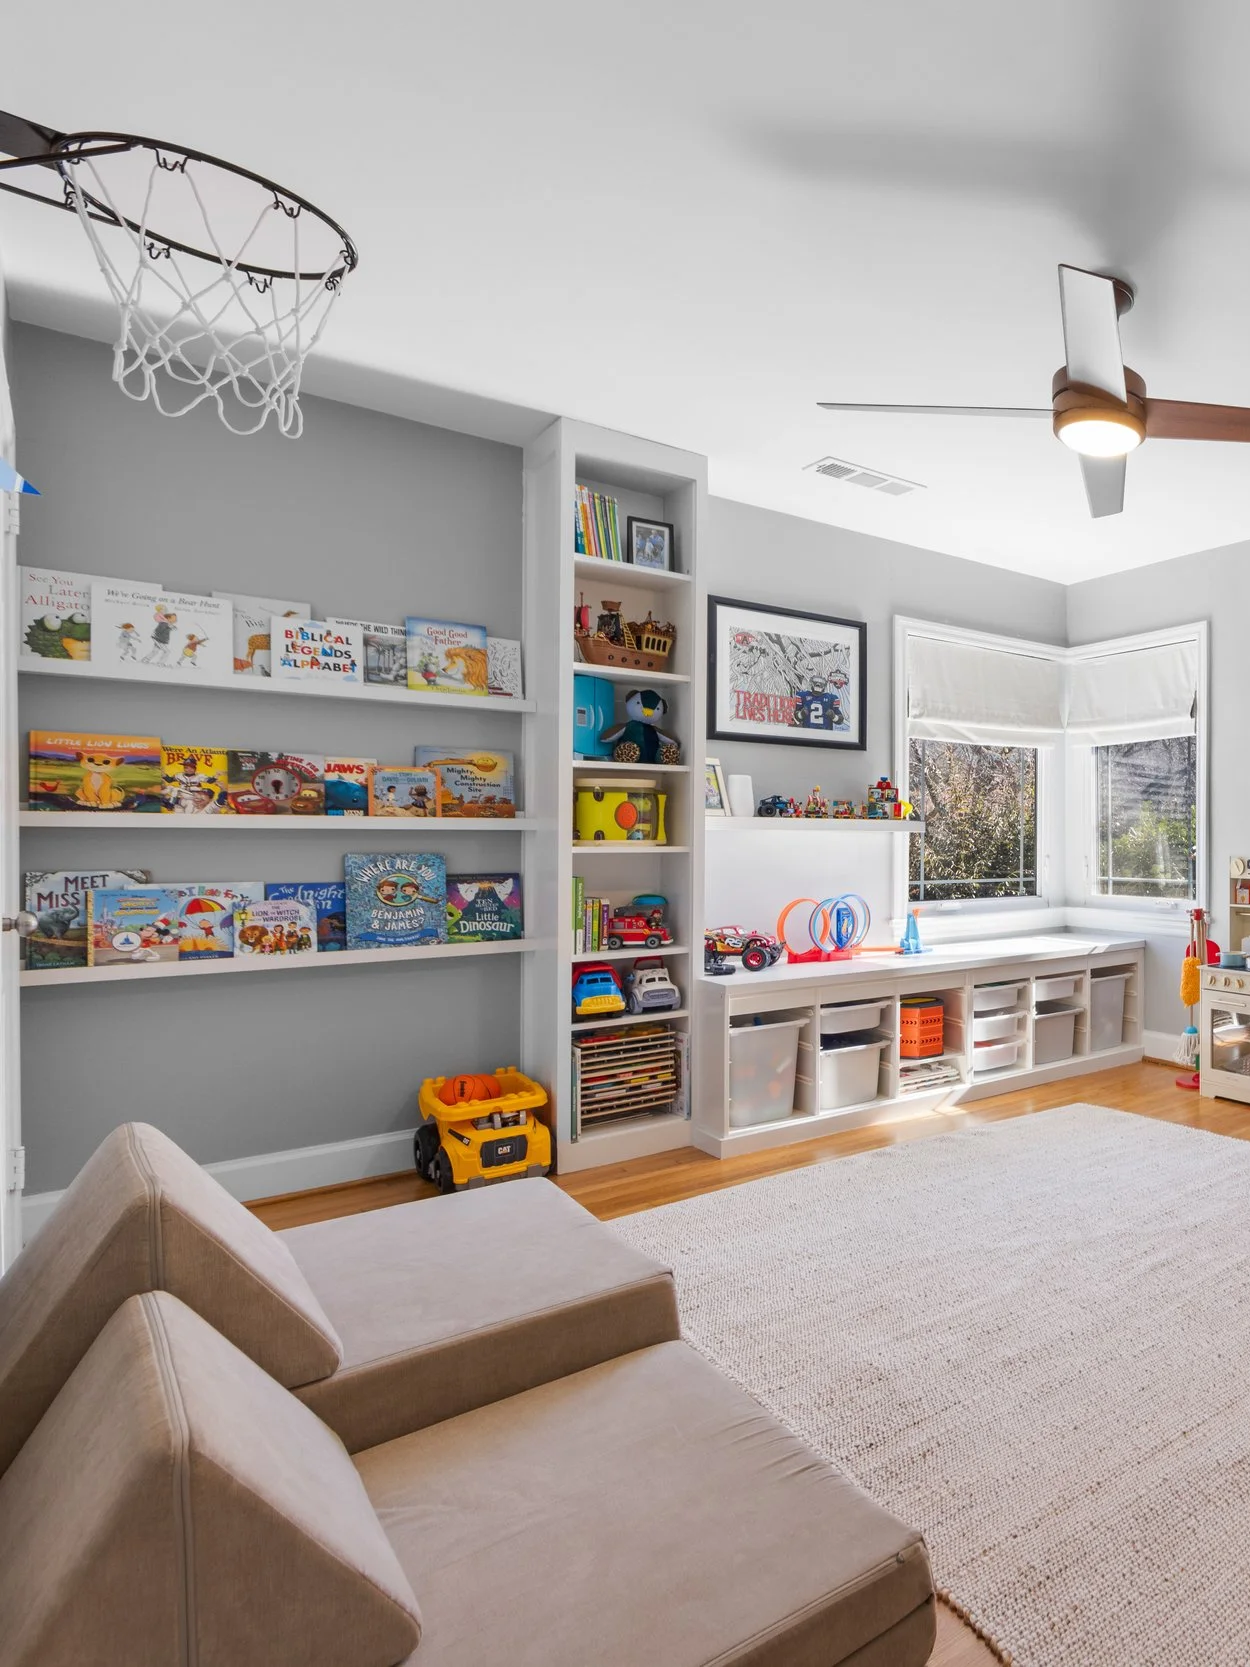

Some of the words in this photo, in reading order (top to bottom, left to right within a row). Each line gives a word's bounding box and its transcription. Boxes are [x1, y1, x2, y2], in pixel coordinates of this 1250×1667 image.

[28, 573, 48, 583] See
[51, 576, 73, 586] You
[48, 585, 89, 598] Later
[131, 592, 157, 603] Going
[178, 597, 197, 607] Bear
[199, 600, 220, 609] Hunt
[284, 627, 352, 646] BIBLICAL
[375, 626, 391, 635] WILD
[426, 627, 446, 636] Good
[448, 630, 468, 639] Good
[434, 637, 462, 646] Father
[285, 643, 352, 660] LEGENDS
[280, 656, 357, 673] ALPHABET
[810, 703, 824, 724] 2
[46, 738, 81, 746] LITTLE
[86, 740, 112, 748] LION
[166, 752, 213, 767] BRAVE
[324, 763, 365, 775] JAWS
[446, 767, 475, 775] Mighty,
[460, 774, 487, 782] Mighty
[354, 861, 393, 884] WHERE
[395, 860, 417, 872] ARE
[418, 865, 436, 881] YOU
[64, 874, 109, 892] MEET
[279, 886, 295, 894] The
[36, 891, 81, 912] MISS
[370, 908, 425, 920] BENJAMIN
[475, 912, 499, 921] Little
[371, 919, 380, 930] &
[385, 918, 425, 931] JAMES?
[459, 921, 515, 933] Dinosaur
[498, 1145, 511, 1155] CAT
